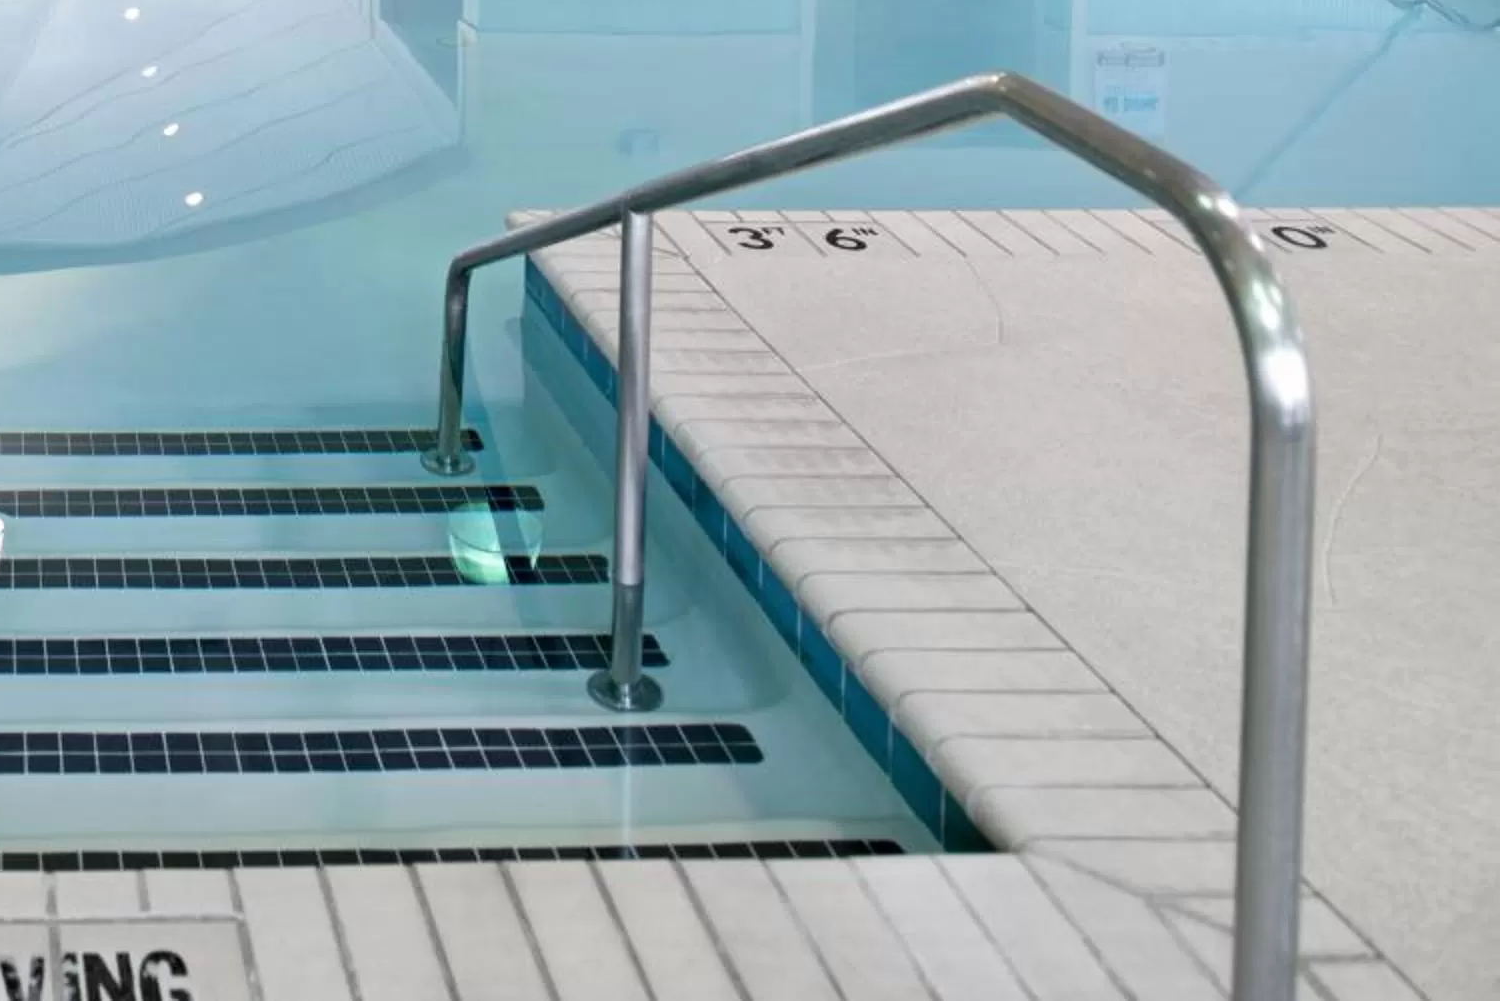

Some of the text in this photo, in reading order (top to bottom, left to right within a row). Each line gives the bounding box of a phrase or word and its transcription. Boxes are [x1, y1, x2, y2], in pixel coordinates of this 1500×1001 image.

[728, 227, 775, 250] 3
[825, 228, 868, 251] 6
[1271, 226, 1328, 249] 0
